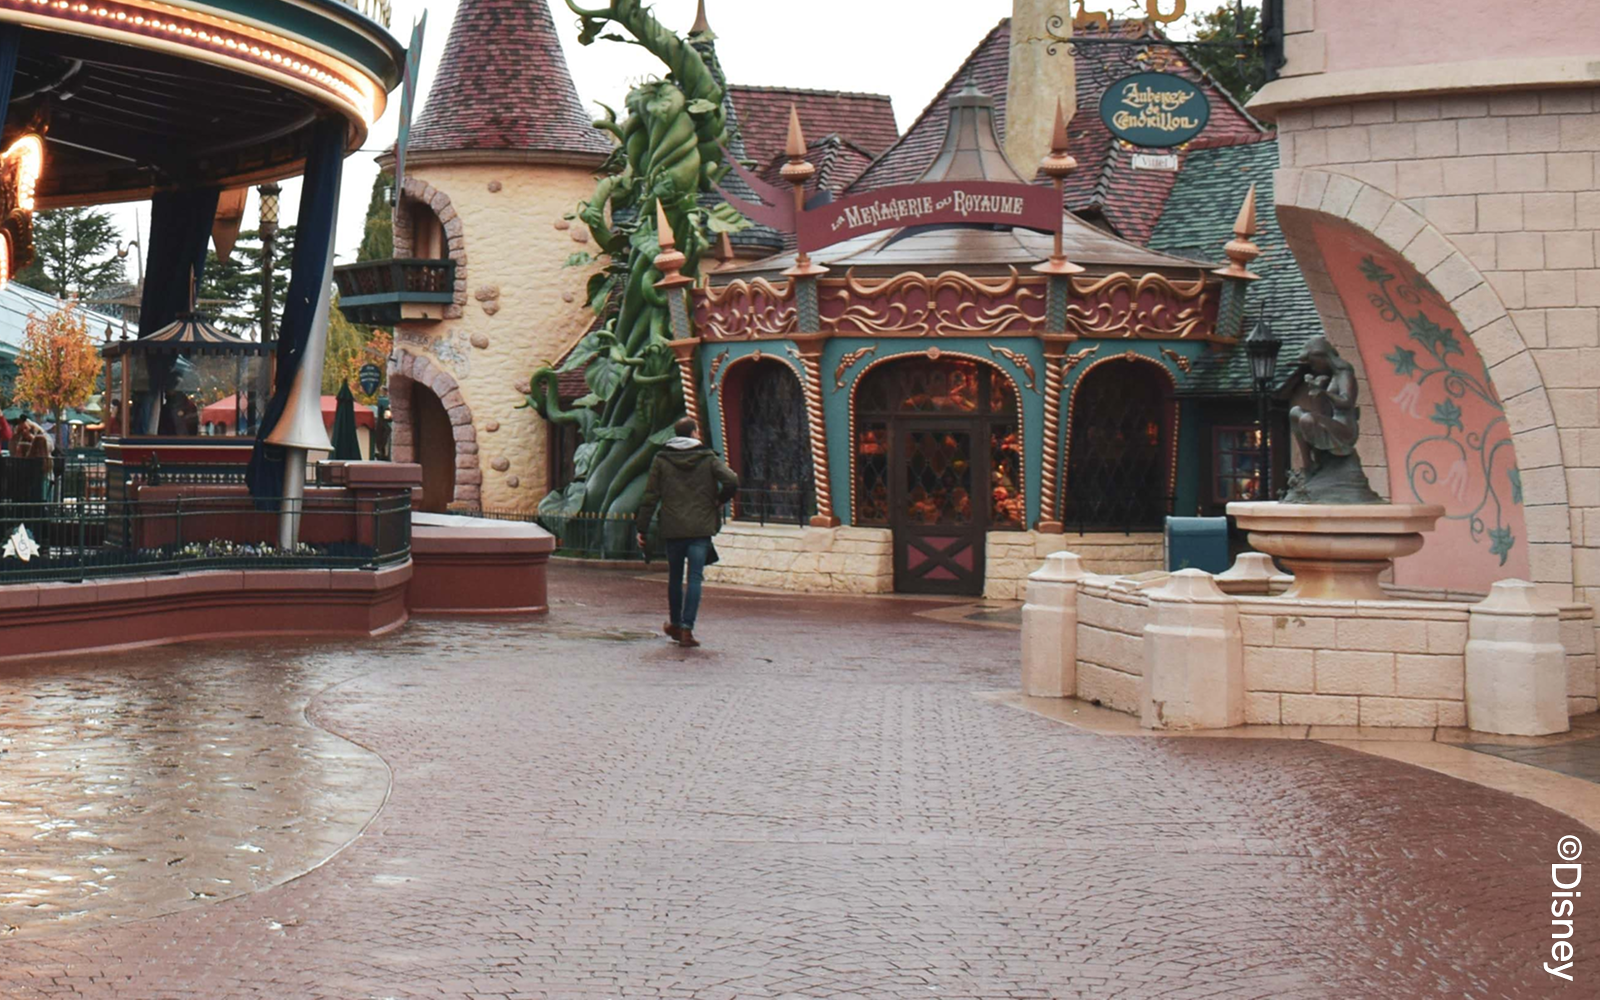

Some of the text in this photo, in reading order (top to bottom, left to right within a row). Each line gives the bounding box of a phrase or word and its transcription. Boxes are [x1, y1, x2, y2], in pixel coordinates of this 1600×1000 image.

[1121, 82, 1195, 111] Auberge
[1145, 103, 1160, 115] de
[1112, 110, 1199, 131] Cendrillon
[831, 190, 1024, 231] LA MENAGERIE DU ROYAUME
